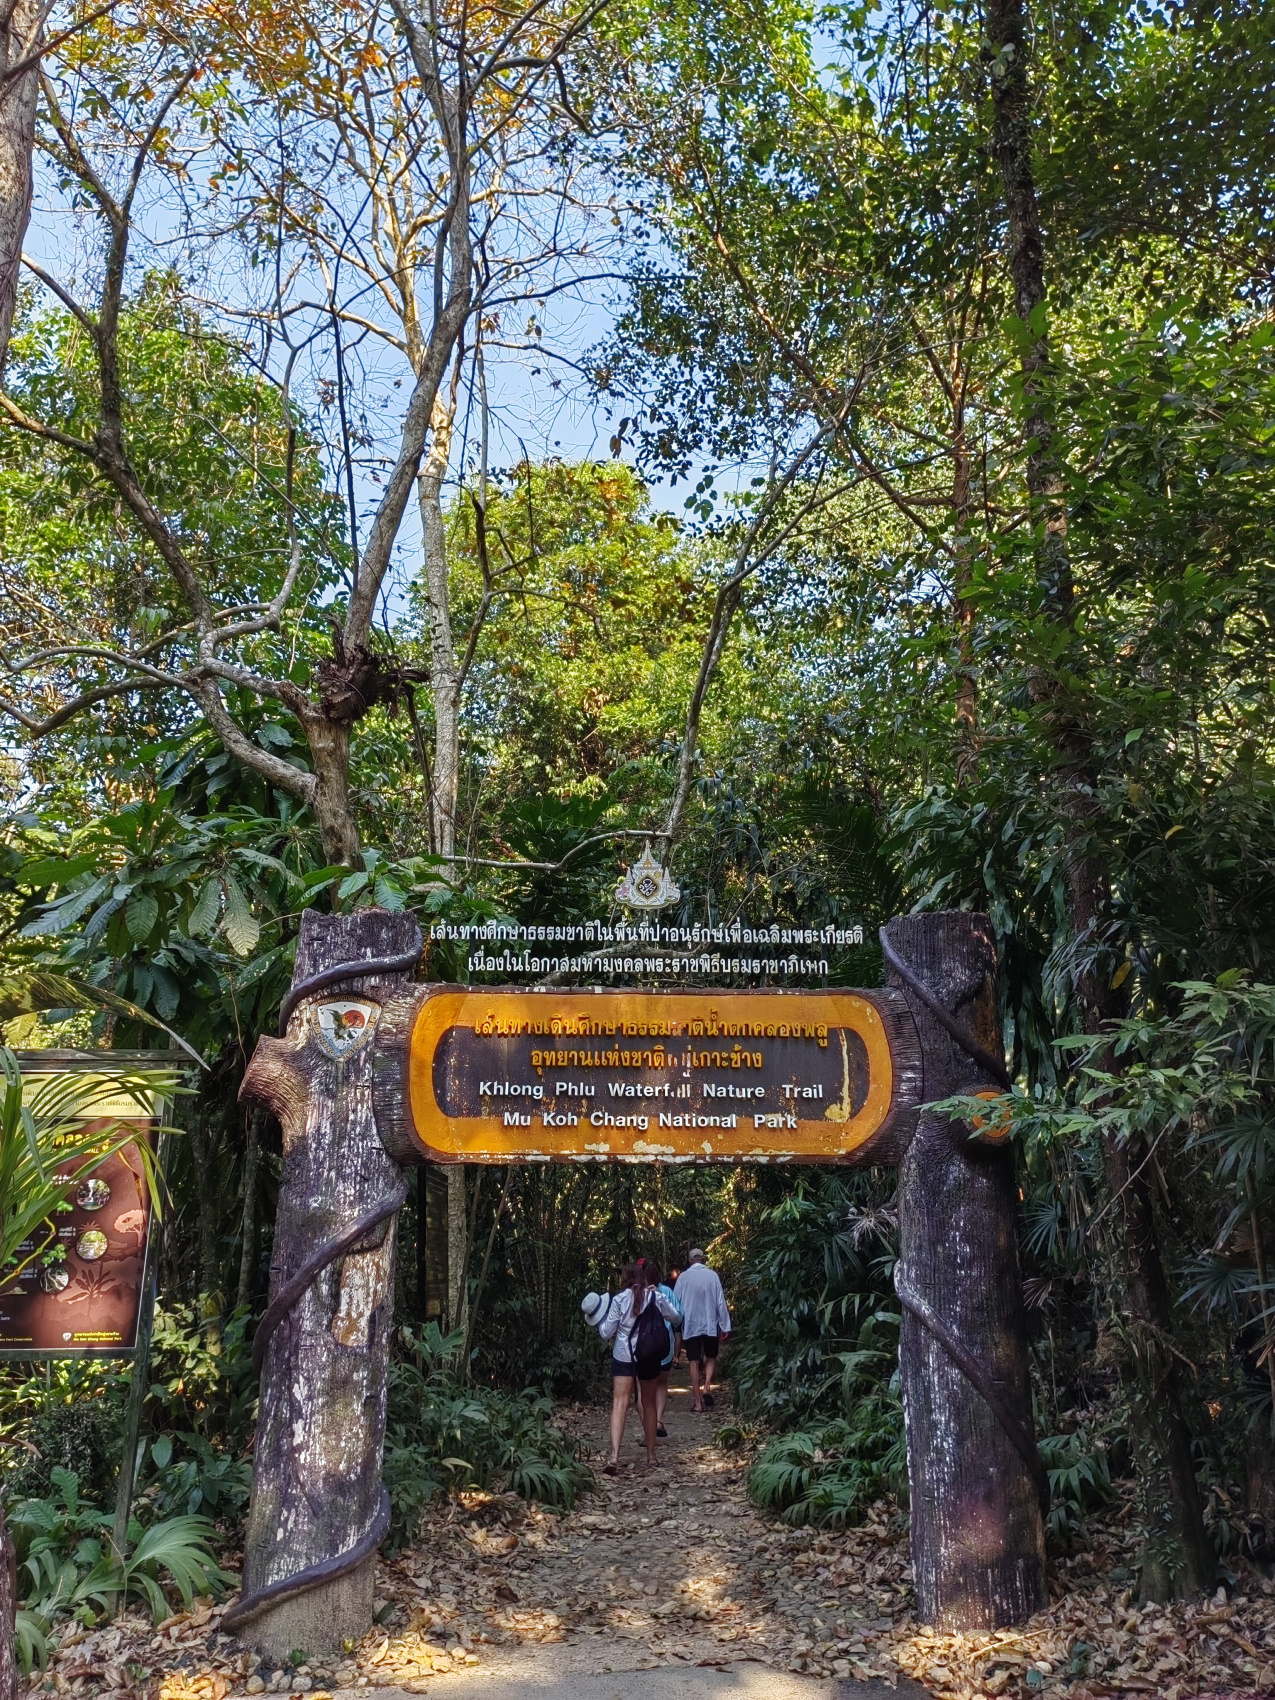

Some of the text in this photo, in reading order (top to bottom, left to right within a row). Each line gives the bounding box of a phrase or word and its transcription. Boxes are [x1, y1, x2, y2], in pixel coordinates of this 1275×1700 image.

[479, 1081, 543, 1100] Khlong
[555, 1081, 595, 1096] Phlu
[703, 1083, 765, 1099] Nature
[782, 1084, 823, 1099] Trail
[503, 1111, 798, 1130] Mu Koh Chang National Park
